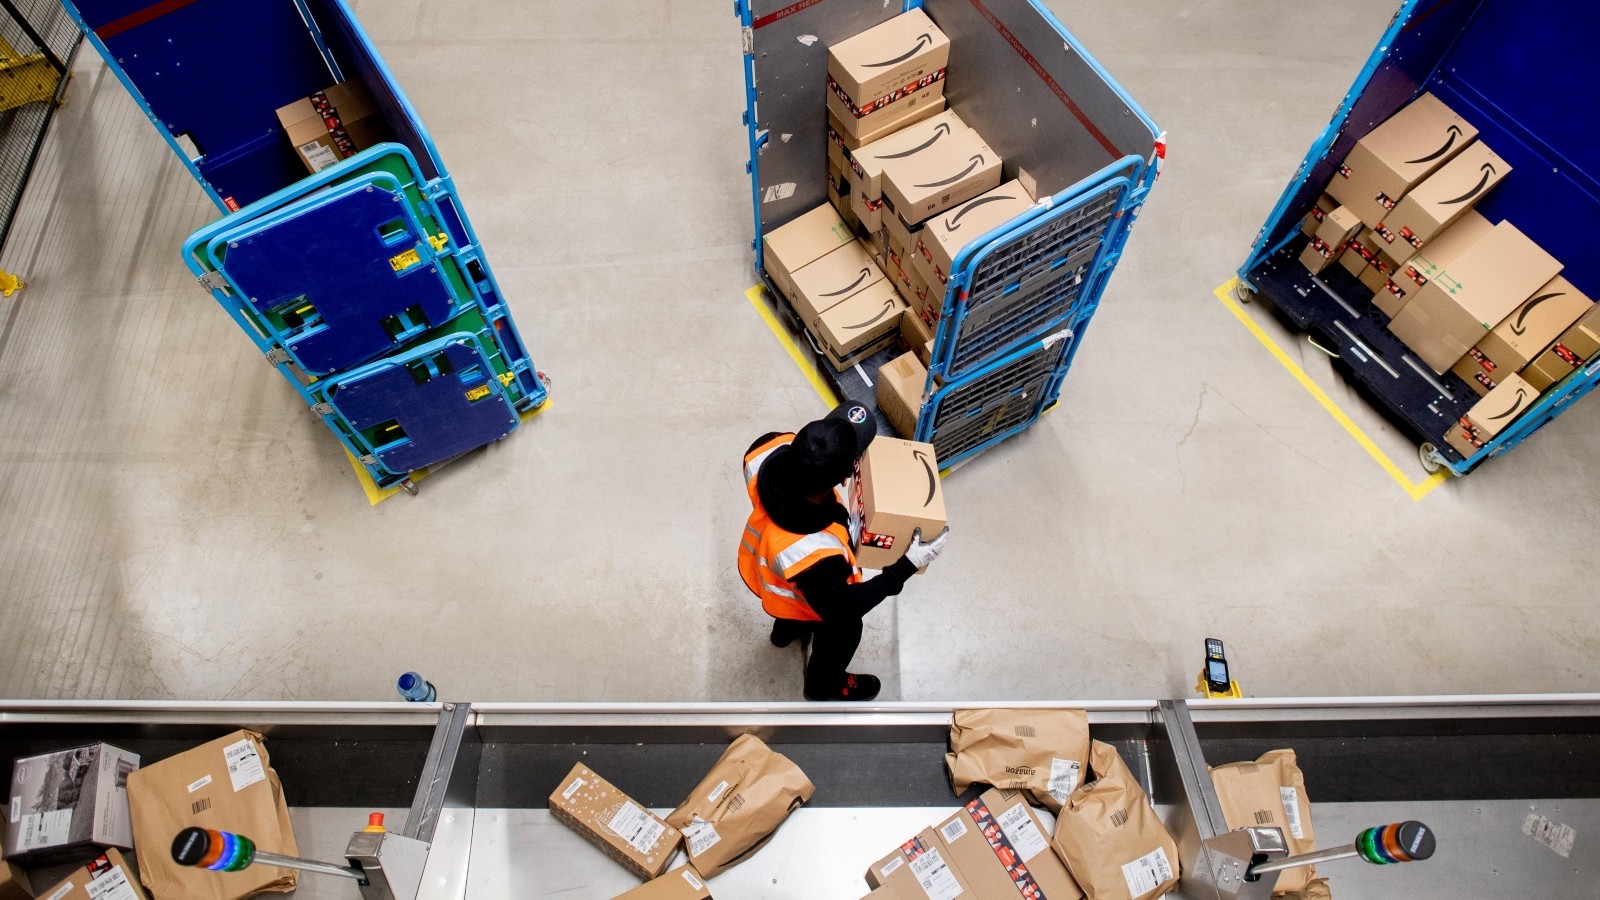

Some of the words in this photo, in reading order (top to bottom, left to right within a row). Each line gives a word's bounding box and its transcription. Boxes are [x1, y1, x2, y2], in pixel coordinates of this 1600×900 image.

[776, 6, 797, 19] MAX
[1002, 29, 1027, 56] HEIGHT
[1028, 58, 1046, 78] LIMIT
[1005, 766, 1036, 776] amazon
[1410, 826, 1425, 853] SIEMENS
